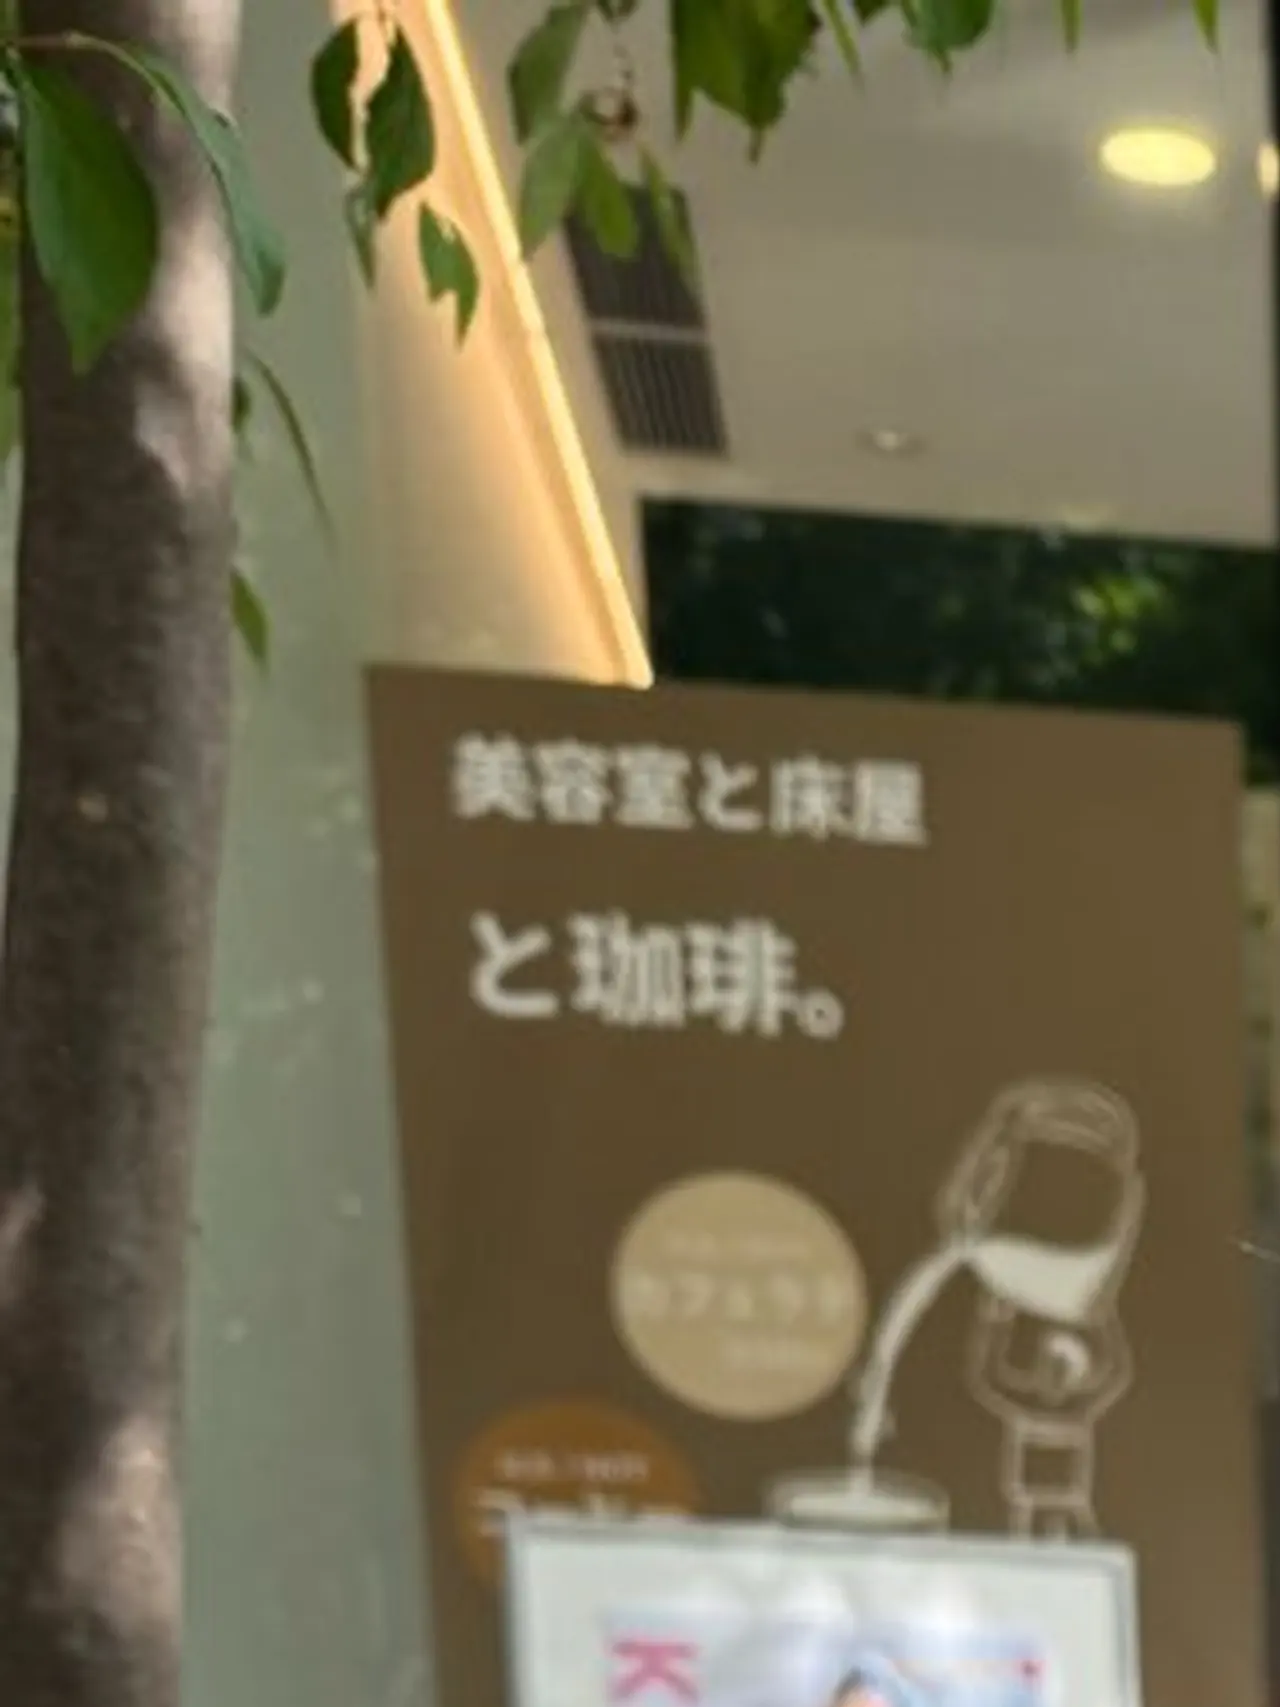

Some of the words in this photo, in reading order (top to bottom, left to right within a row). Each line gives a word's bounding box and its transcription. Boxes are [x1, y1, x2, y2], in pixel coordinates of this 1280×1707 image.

[453, 733, 928, 848] 美容室と床屋
[470, 909, 845, 1041] と珈琲。
